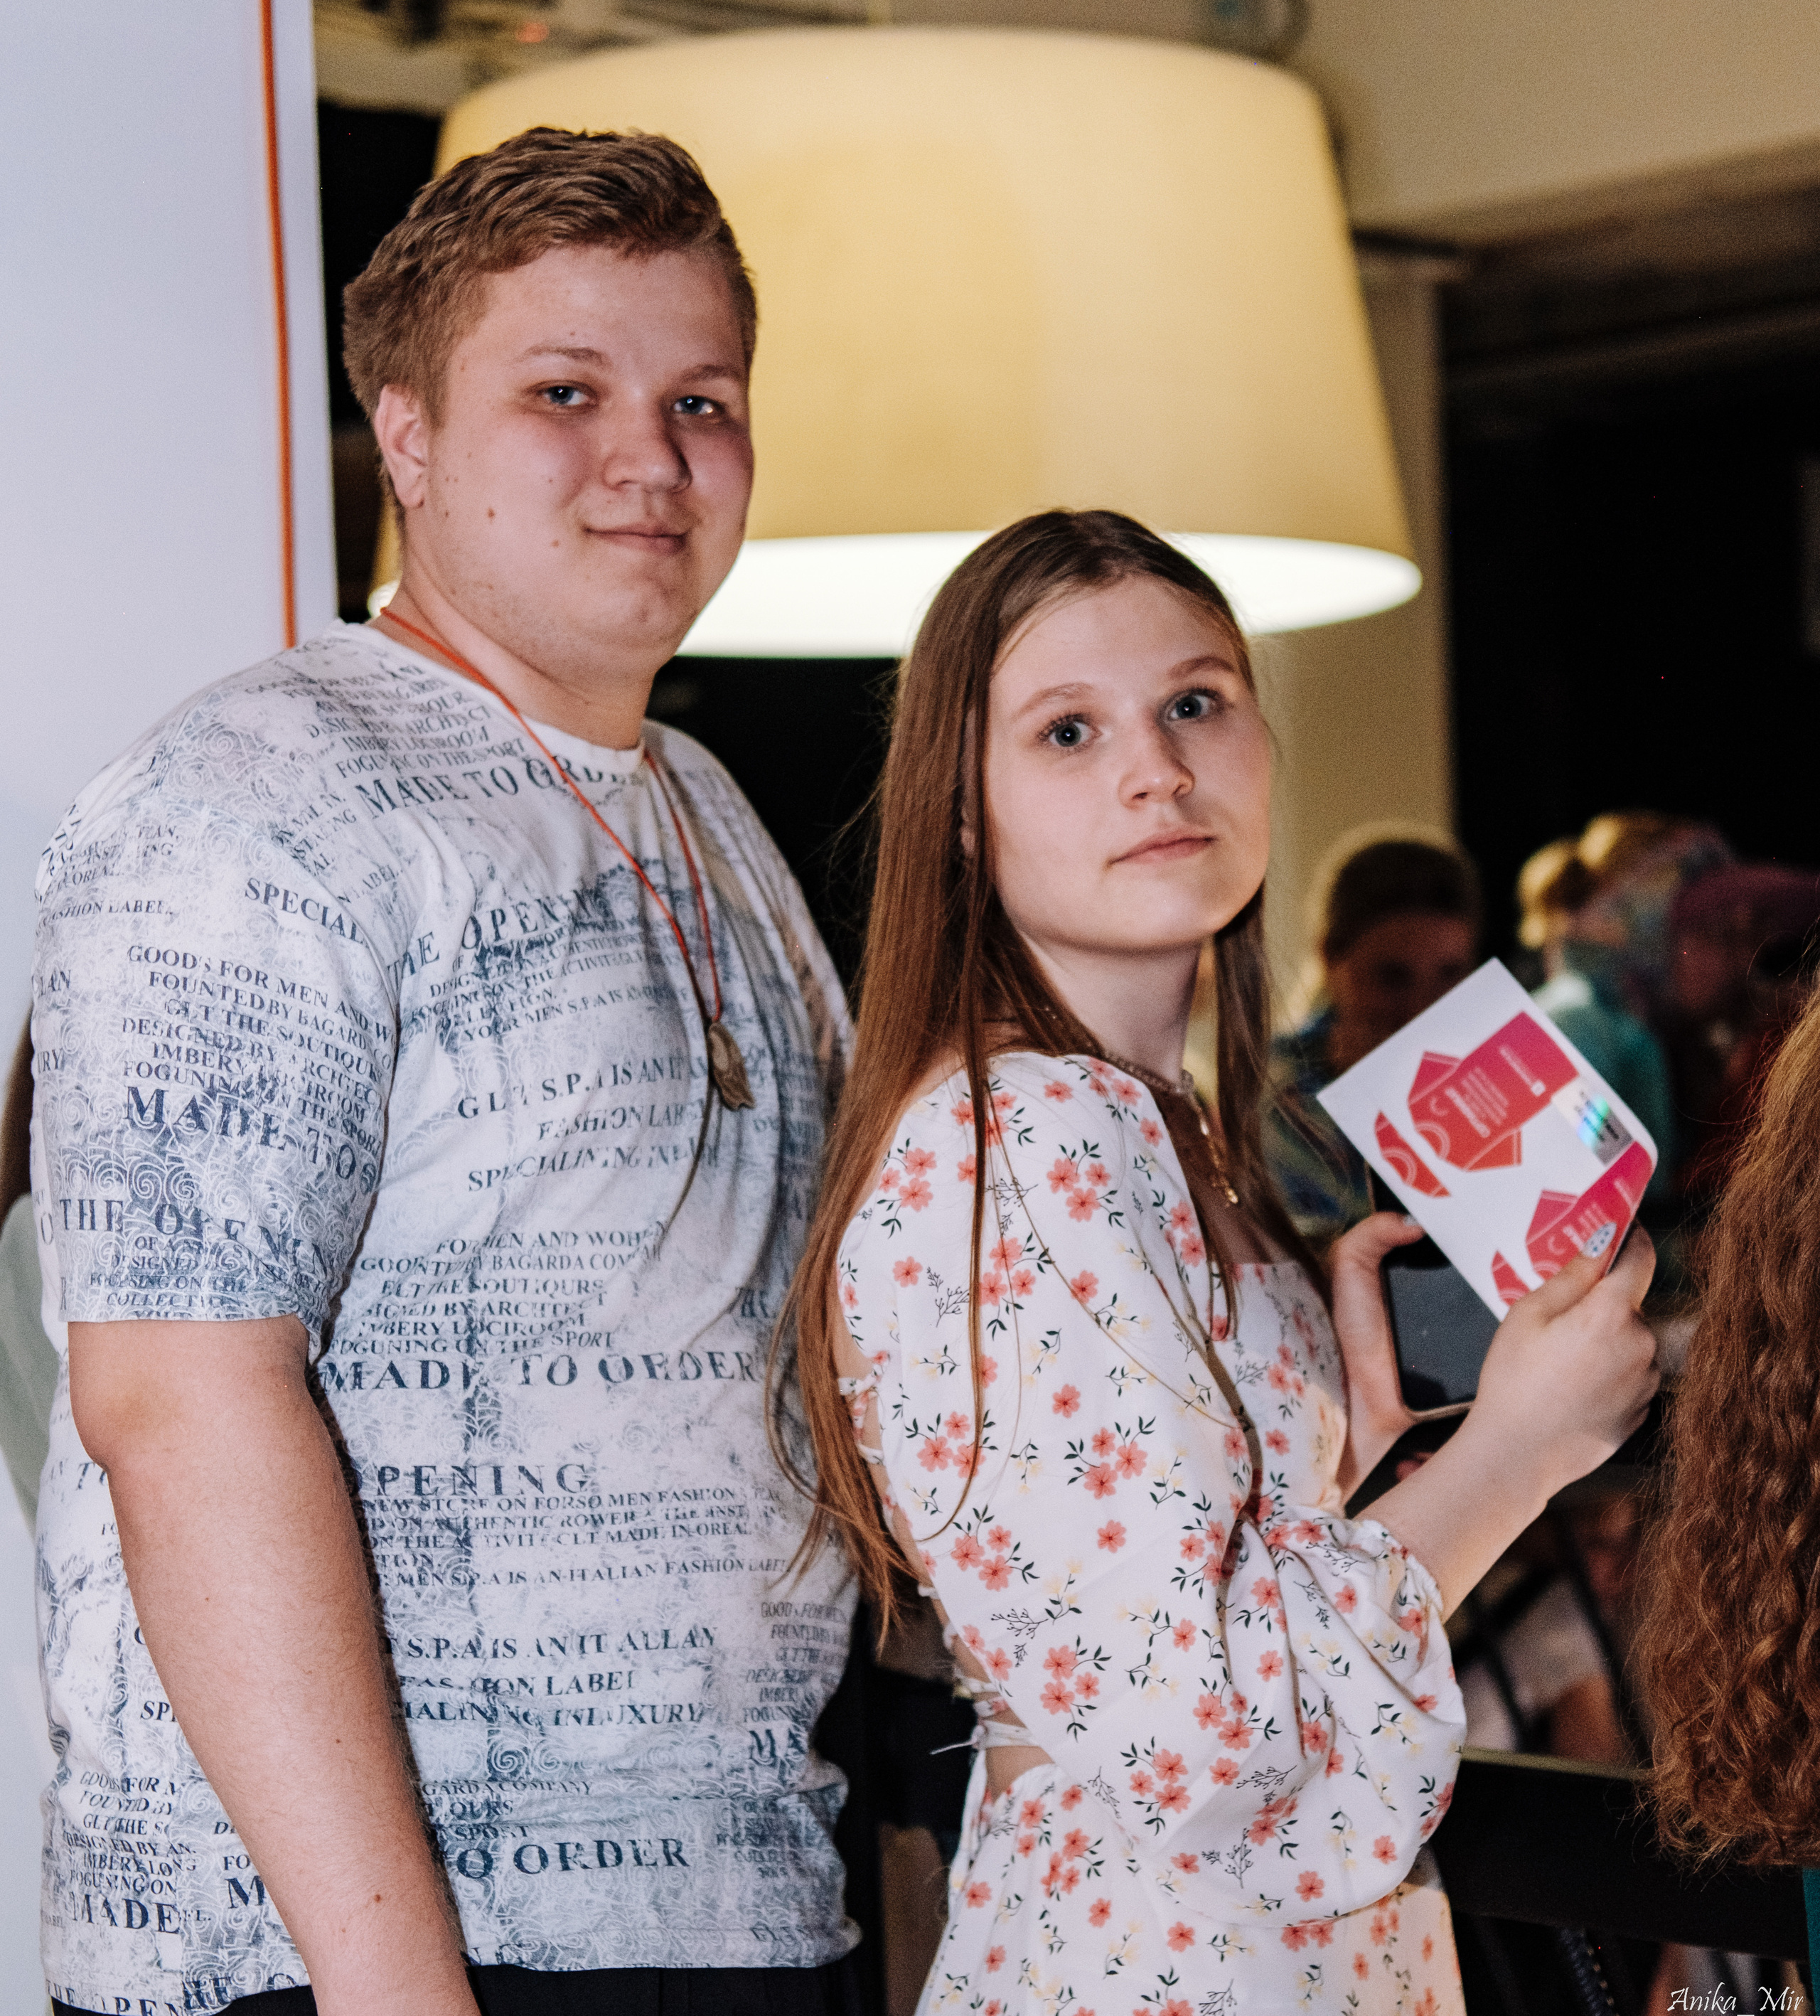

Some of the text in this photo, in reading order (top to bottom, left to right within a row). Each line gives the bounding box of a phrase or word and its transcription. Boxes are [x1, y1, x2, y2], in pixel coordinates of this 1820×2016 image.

[462, 764, 519, 799] TO
[219, 959, 269, 990] FOR
[277, 976, 328, 1009] MEN
[335, 1000, 369, 1031] AND
[221, 1008, 269, 1038] THE
[124, 1086, 285, 1151] MADE
[59, 1198, 124, 1232] THE
[510, 1354, 578, 1387] TO
[491, 1638, 518, 1659] IS
[513, 1838, 690, 1875] ORDER
